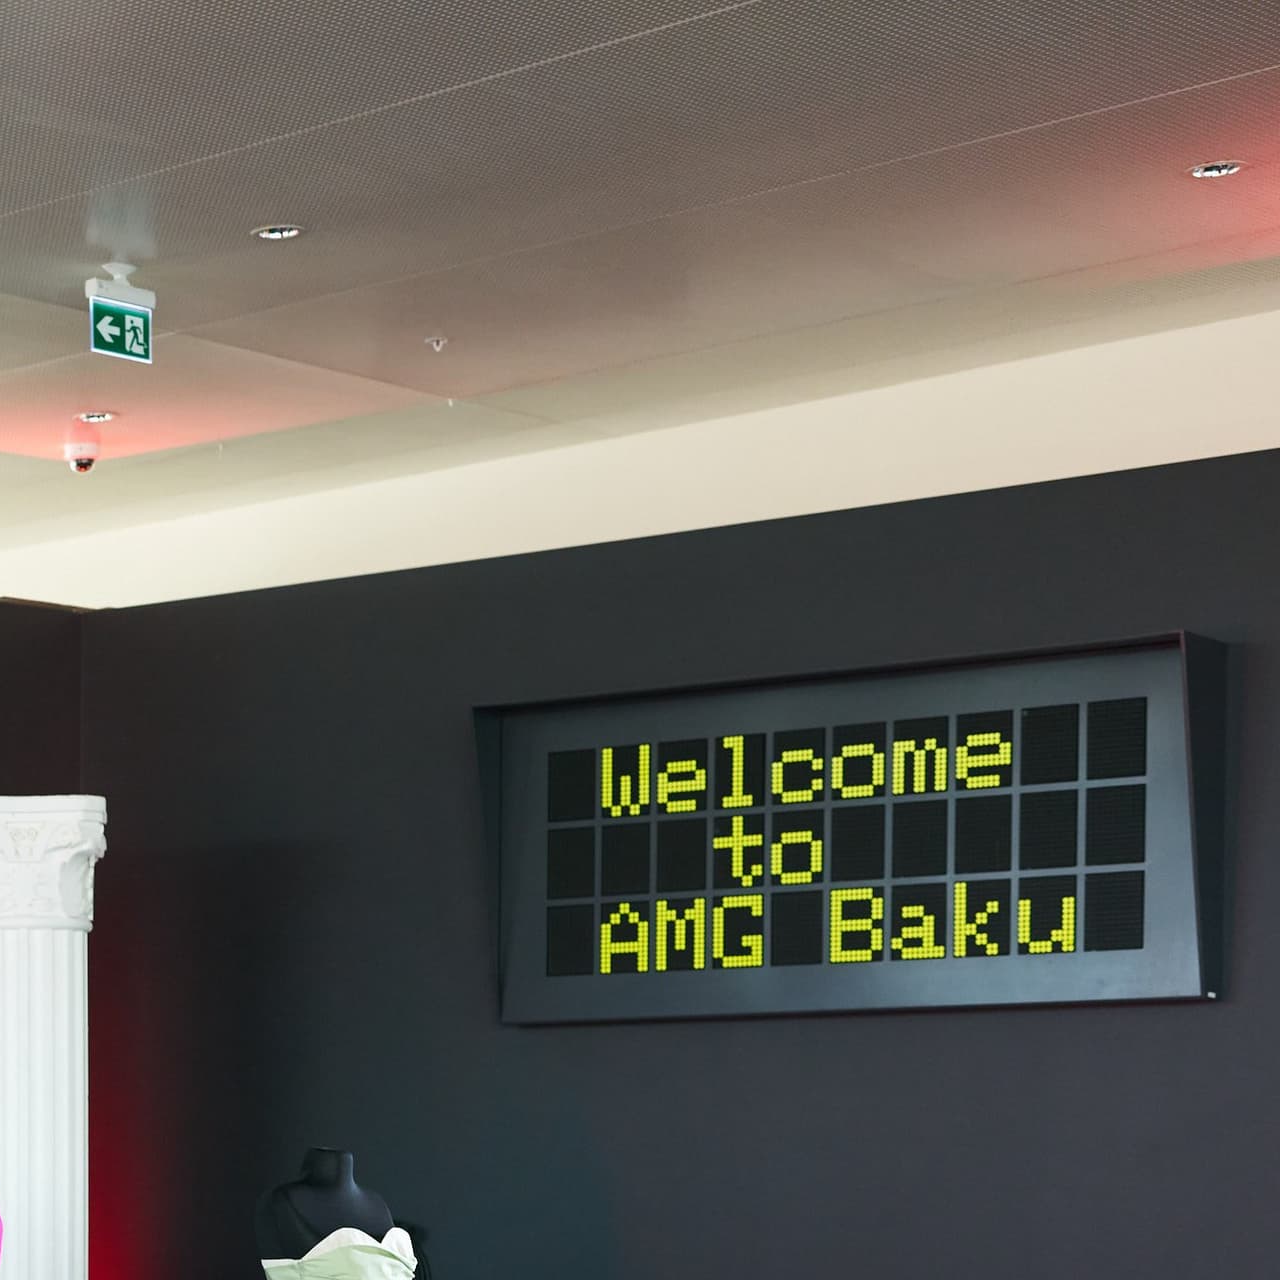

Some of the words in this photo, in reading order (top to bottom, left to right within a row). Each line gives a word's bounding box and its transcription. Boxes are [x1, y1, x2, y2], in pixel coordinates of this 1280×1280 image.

[601, 731, 1012, 818] Welcome
[712, 815, 823, 887] to
[599, 894, 763, 974] AMG
[829, 881, 1075, 963] Baku
